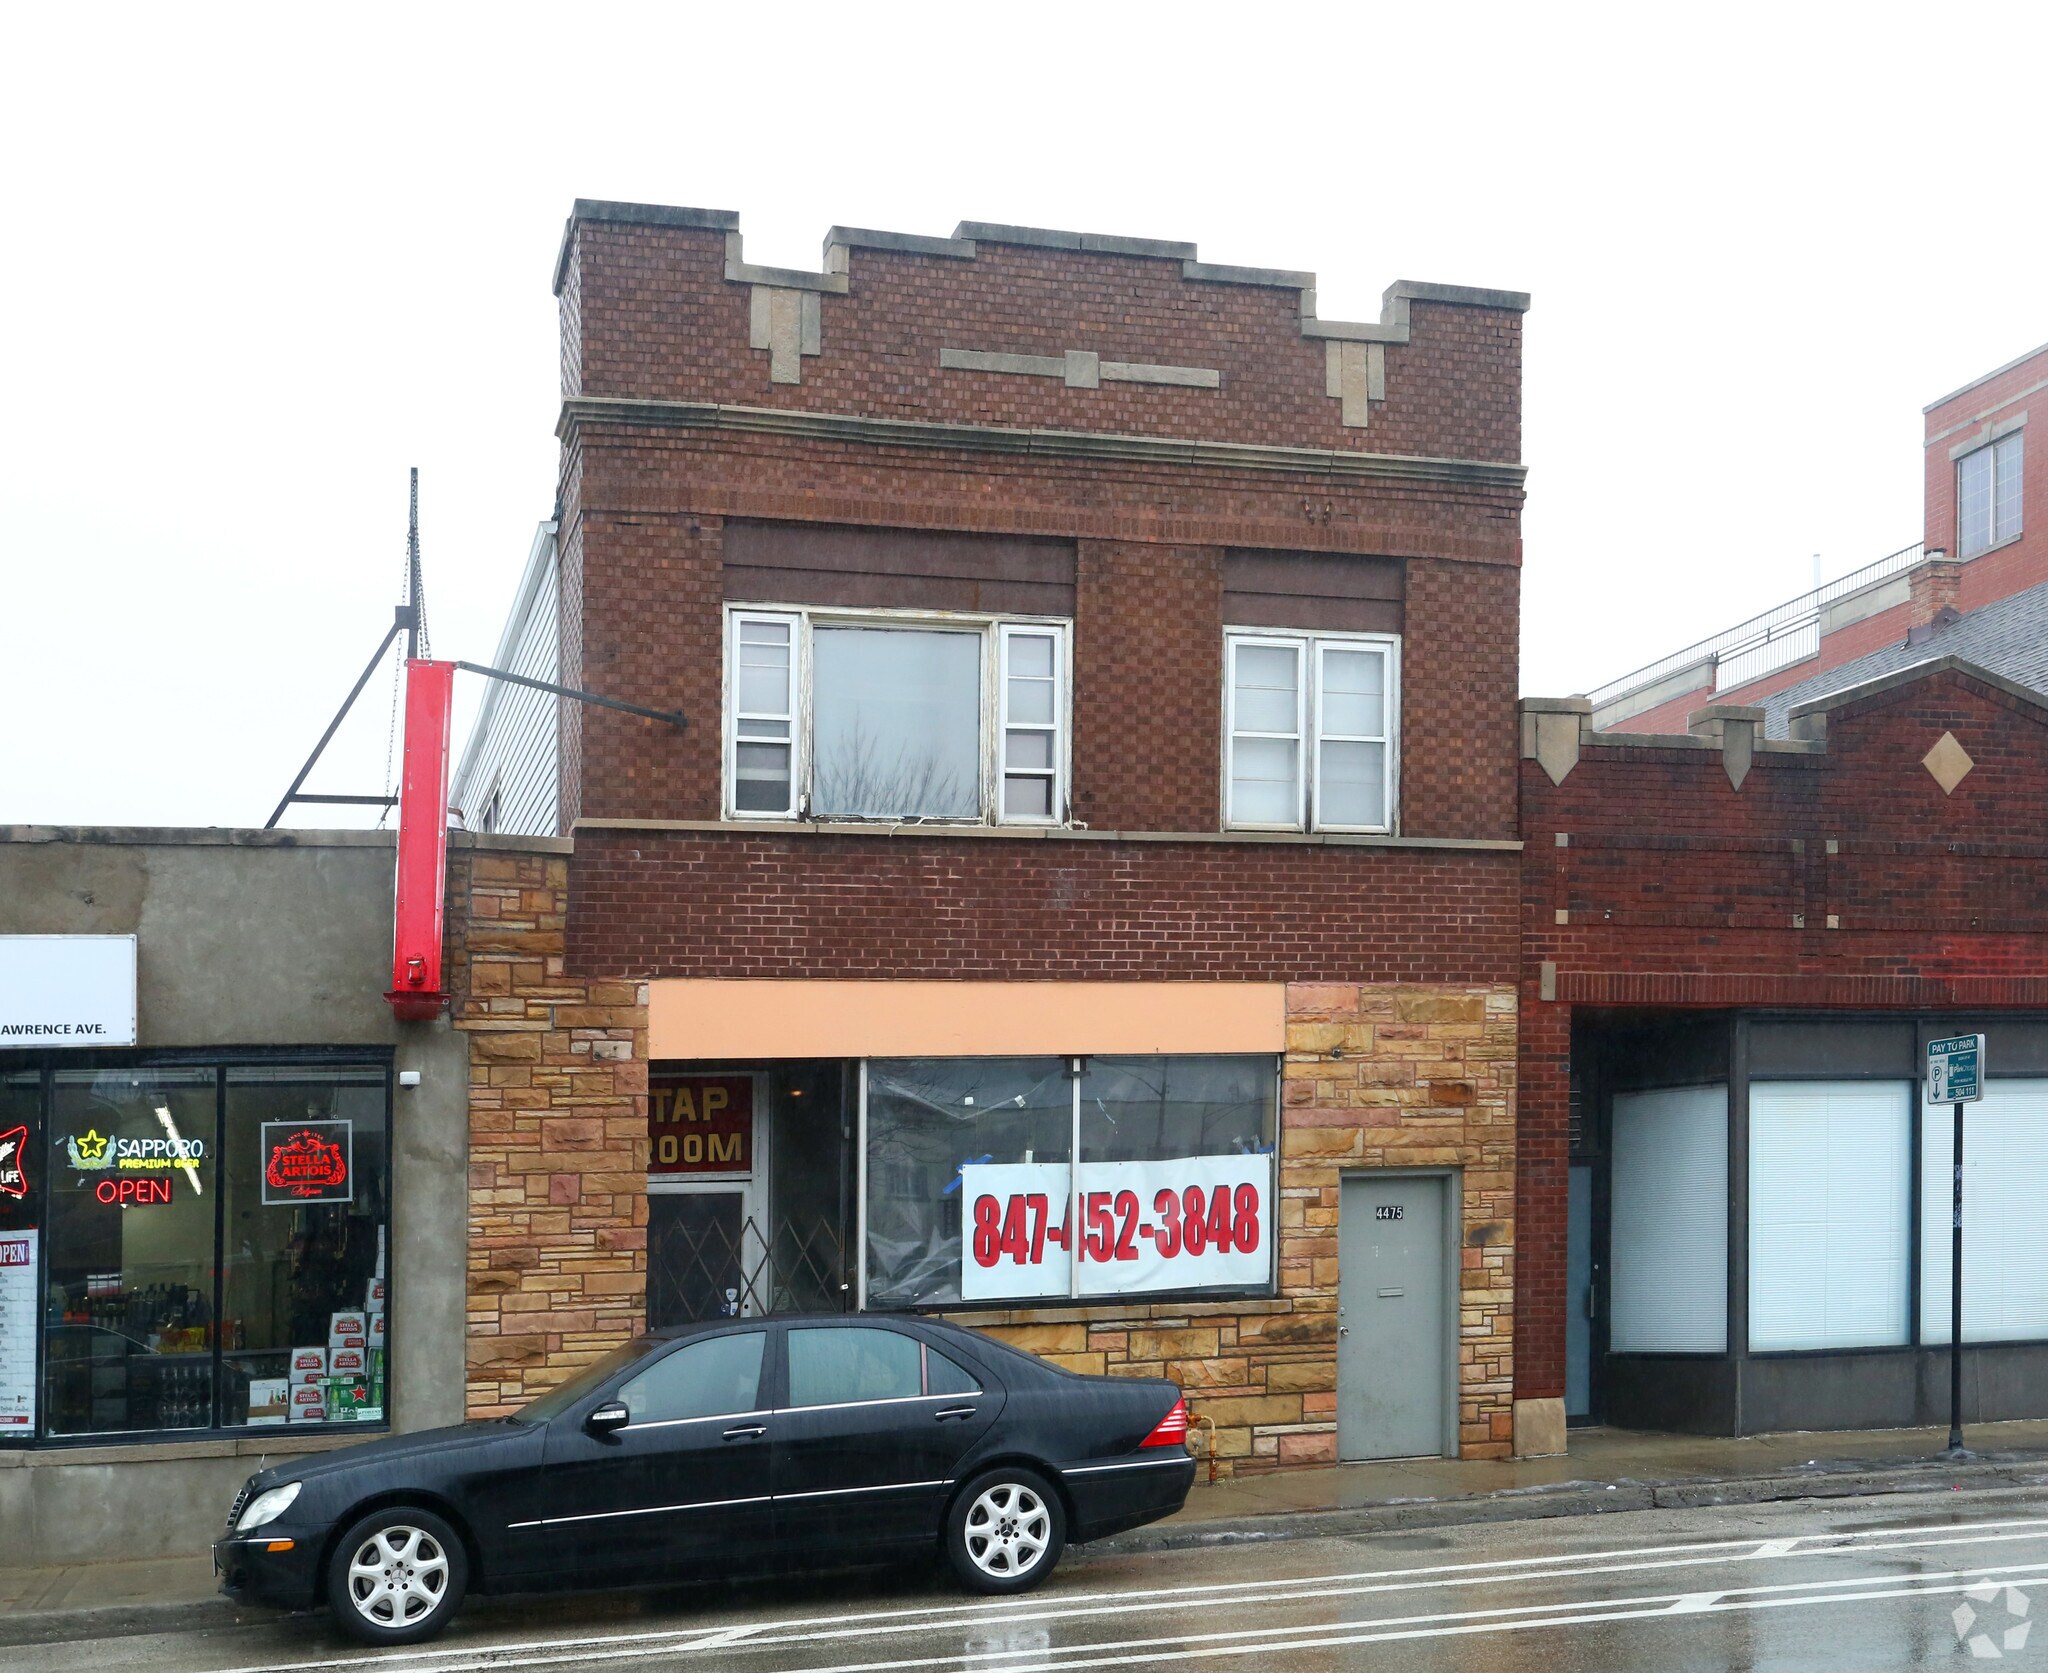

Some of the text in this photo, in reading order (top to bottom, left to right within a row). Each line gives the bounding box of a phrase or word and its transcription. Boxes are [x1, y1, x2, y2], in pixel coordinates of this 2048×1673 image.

[75, 1024, 107, 1034] AVE.
[1932, 1039, 1975, 1054] PAY TO PARK
[648, 1087, 729, 1123] TAP
[117, 1139, 204, 1158] SAPPORO
[119, 1158, 200, 1169] PREMIUM BEER
[282, 1154, 331, 1166] STELLA
[1, 1170, 20, 1183] LIFE
[281, 1165, 332, 1177] ARTOIS
[96, 1178, 171, 1204] OPEN
[1376, 1207, 1403, 1219] 4475
